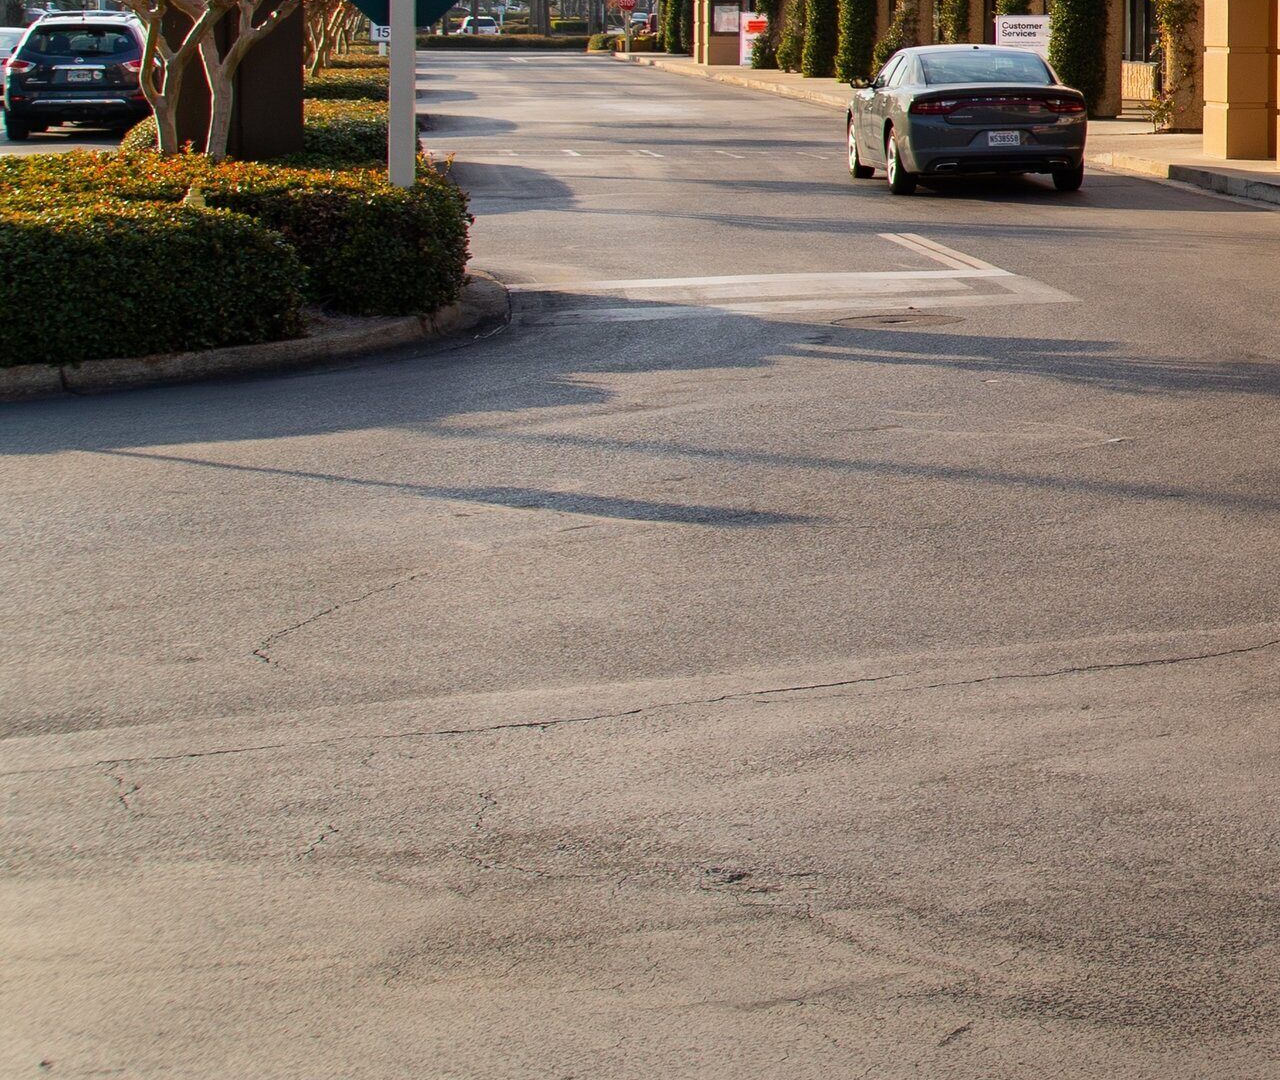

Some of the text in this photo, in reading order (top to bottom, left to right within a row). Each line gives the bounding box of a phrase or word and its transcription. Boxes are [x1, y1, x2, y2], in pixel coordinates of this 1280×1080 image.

[620, 0, 635, 7] STOP
[1001, 21, 1043, 30] Customer
[375, 27, 390, 38] 15
